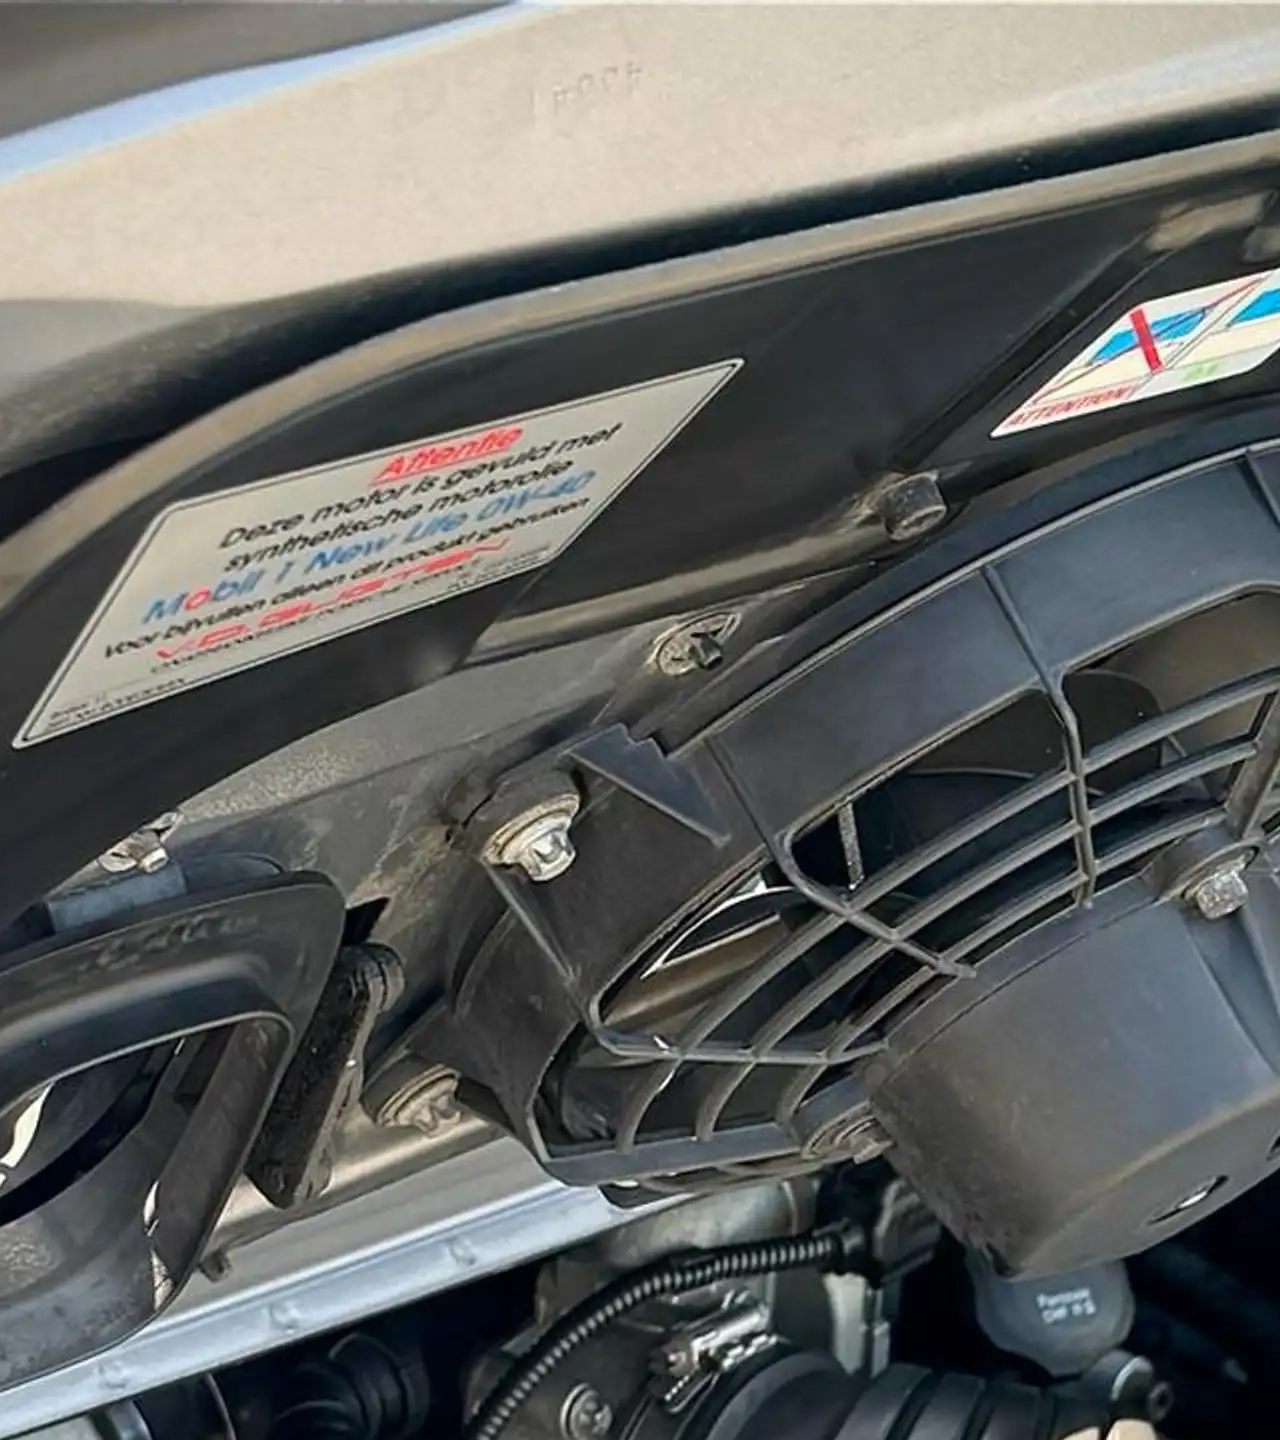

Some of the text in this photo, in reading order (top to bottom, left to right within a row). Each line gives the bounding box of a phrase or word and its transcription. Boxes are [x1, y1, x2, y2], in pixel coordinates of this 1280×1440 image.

[219, 422, 623, 549] Deze motor is gevuld met
[372, 427, 523, 485] Attentie
[142, 566, 267, 625] Mobil
[275, 560, 296, 585] 1
[304, 533, 398, 575] New
[403, 510, 469, 545] Life
[223, 503, 424, 572] synthetische
[428, 460, 574, 513] motorolie
